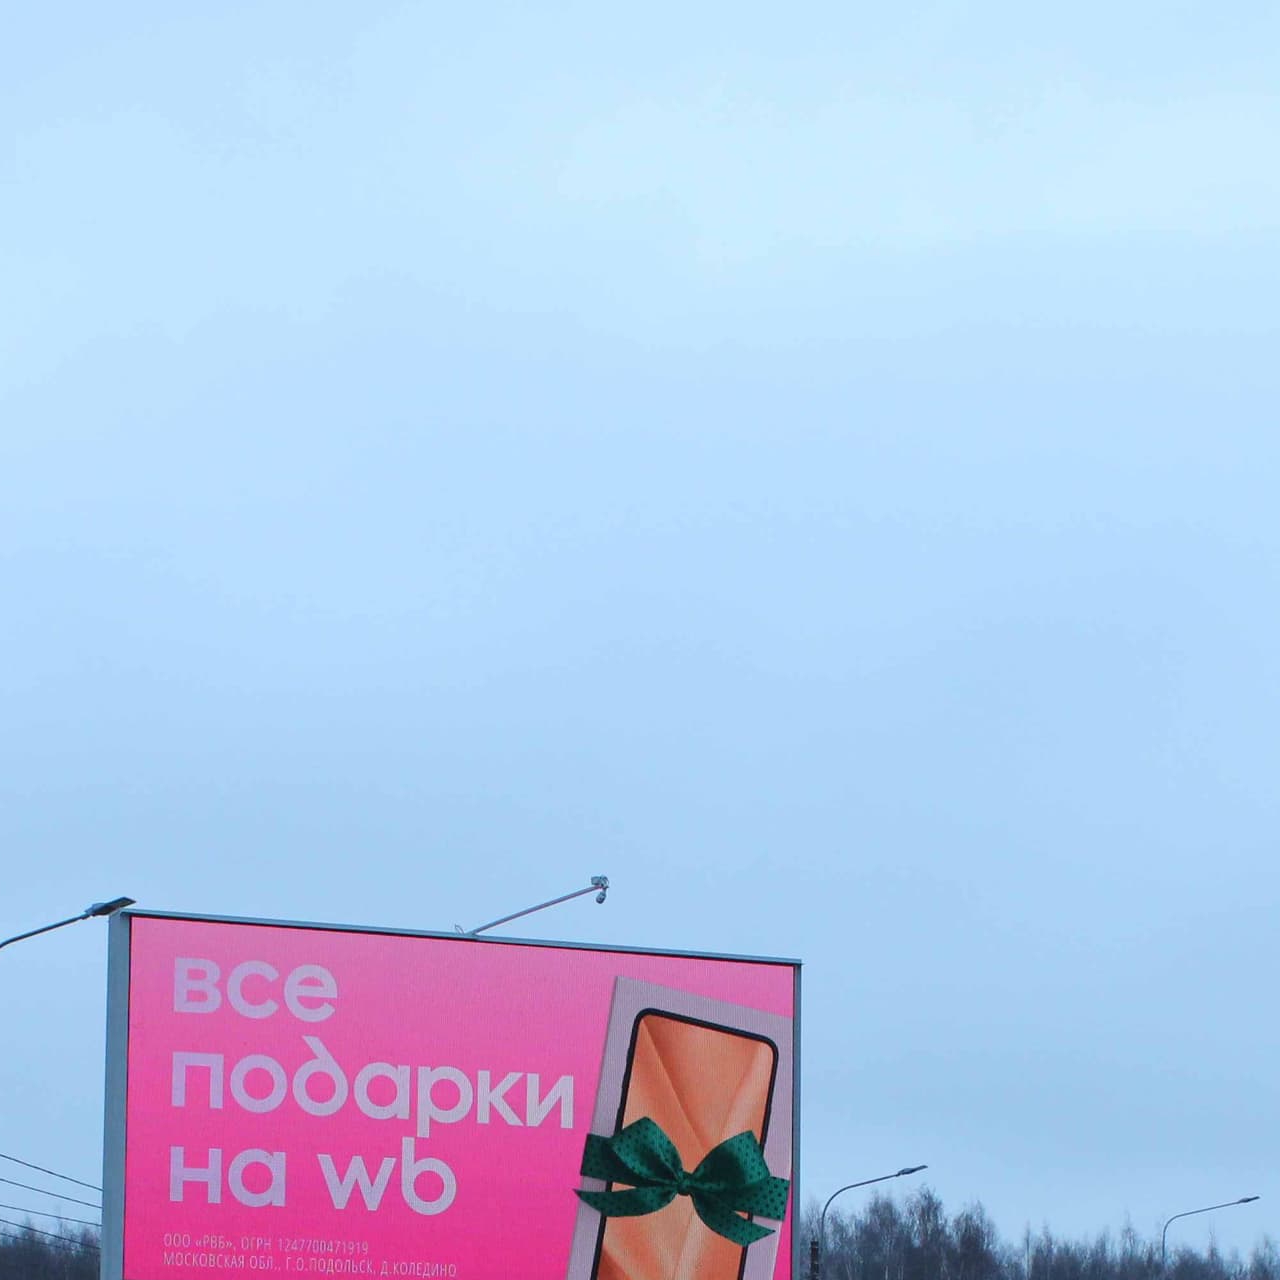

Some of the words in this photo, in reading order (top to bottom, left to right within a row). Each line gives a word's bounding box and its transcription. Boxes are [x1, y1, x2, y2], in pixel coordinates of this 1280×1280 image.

[173, 957, 338, 1023] все
[171, 1035, 574, 1138] подарки
[169, 1145, 287, 1208] на
[317, 1136, 457, 1216] wb
[163, 1232, 191, 1248] ООО
[241, 1236, 272, 1251] ОГРН
[163, 1251, 245, 1269] МОСКОВСКАЯ
